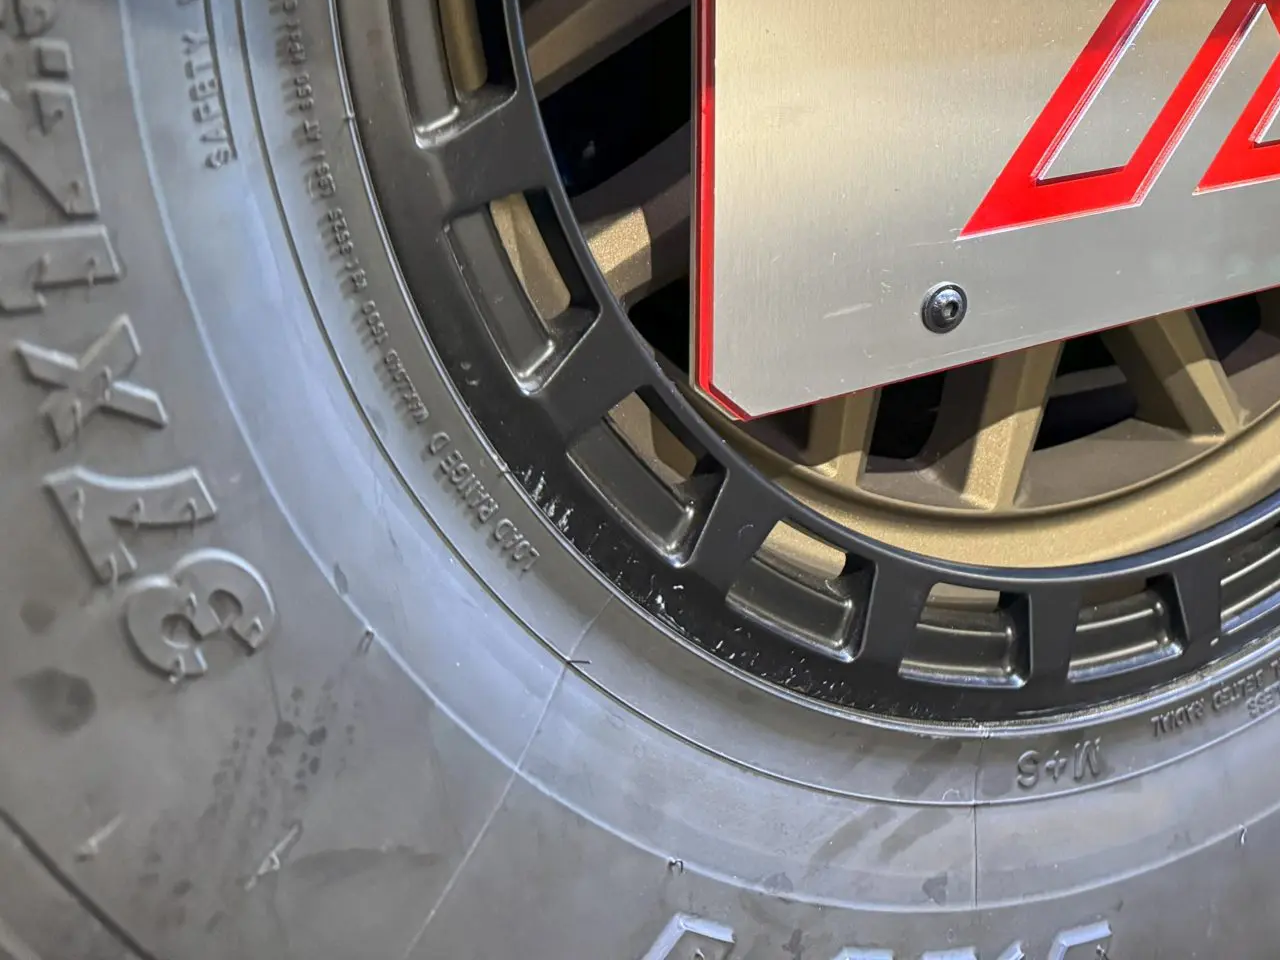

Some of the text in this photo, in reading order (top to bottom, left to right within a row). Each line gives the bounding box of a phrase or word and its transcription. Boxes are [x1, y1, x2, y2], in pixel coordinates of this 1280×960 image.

[182, 30, 231, 169] SAFETY
[428, 431, 541, 572] LOAD RANGE D
[1015, 737, 1104, 790] M+S
[1150, 697, 1205, 738] RADIAL
